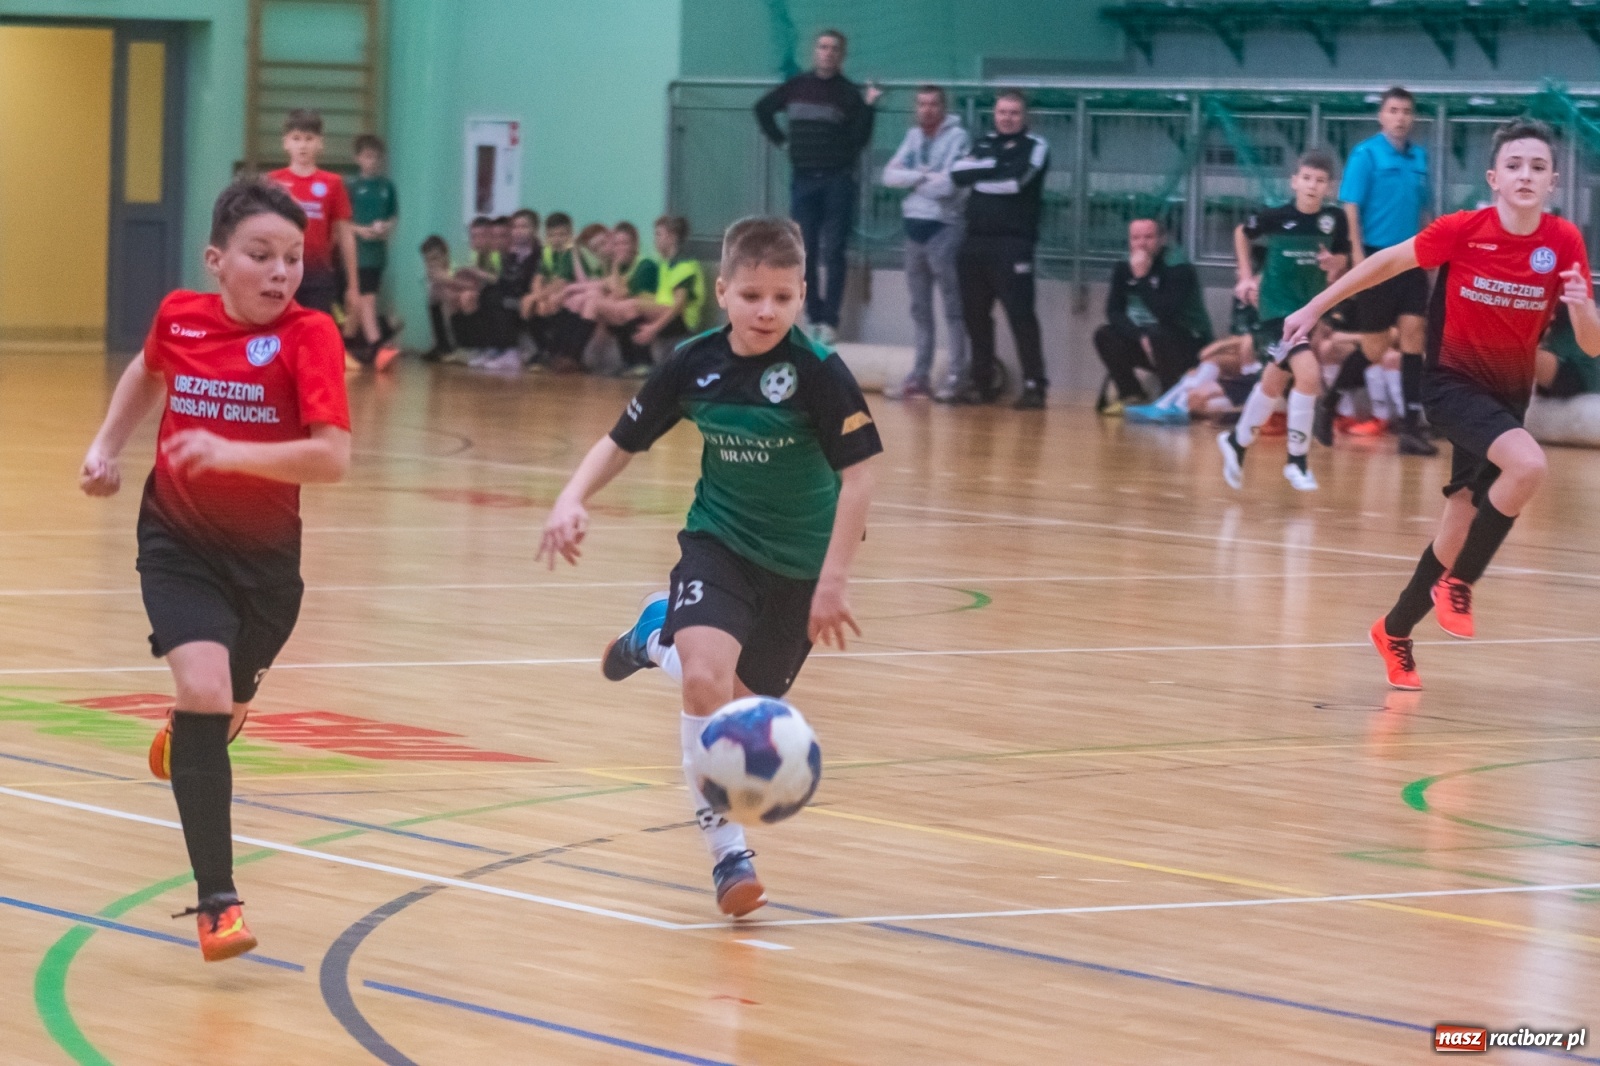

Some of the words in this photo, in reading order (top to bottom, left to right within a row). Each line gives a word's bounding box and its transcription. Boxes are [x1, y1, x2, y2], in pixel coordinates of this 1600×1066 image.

[174, 374, 264, 401] UBEZPIECZENIA
[223, 403, 280, 423] GRUCHEL
[721, 449, 769, 463] BRAVO
